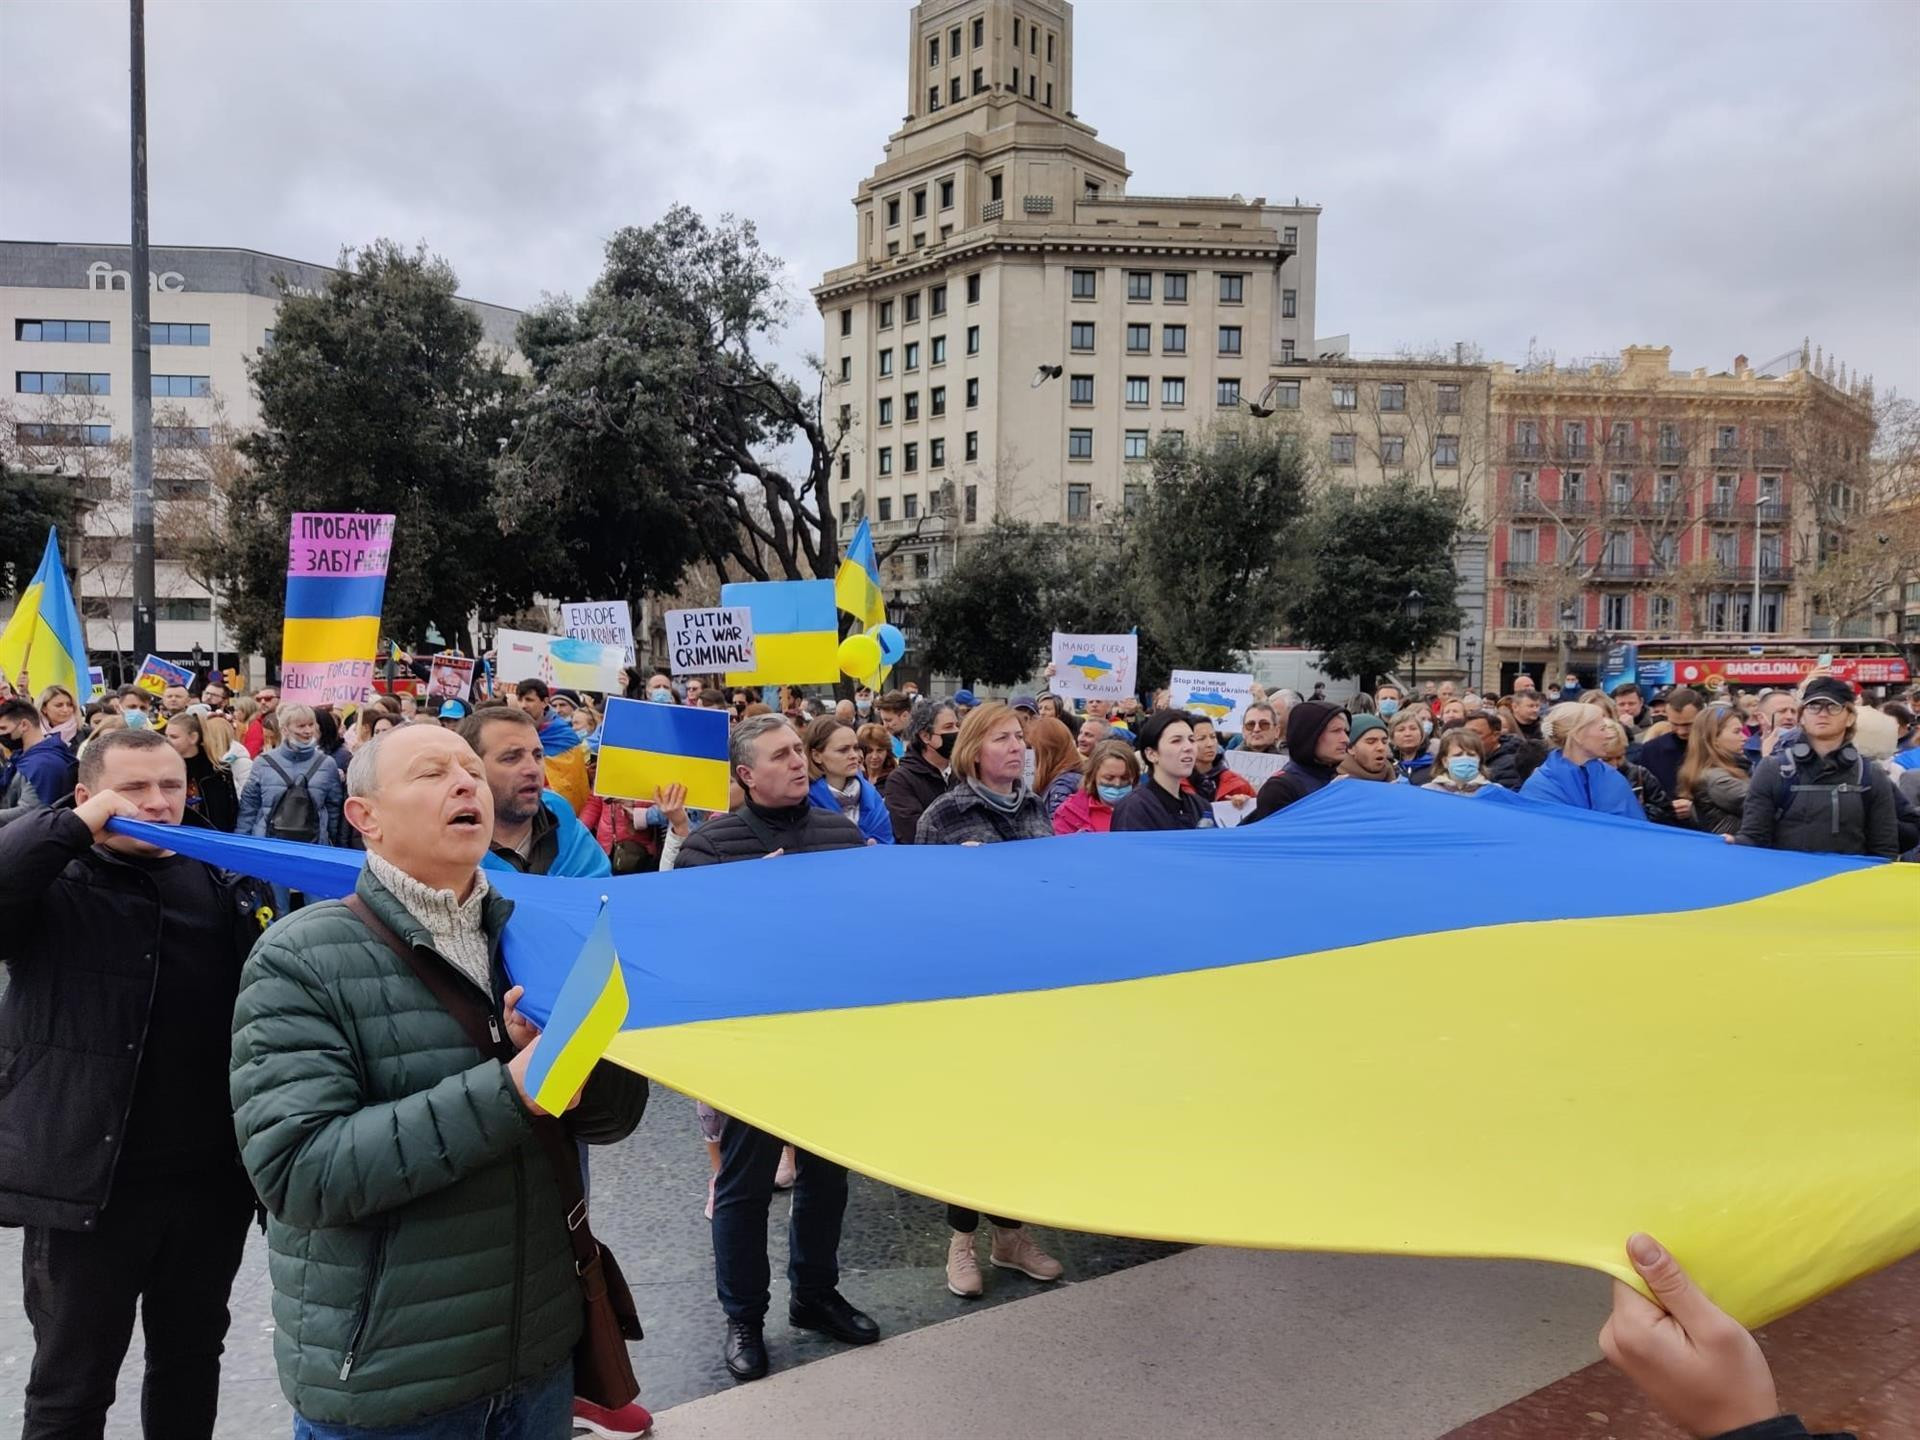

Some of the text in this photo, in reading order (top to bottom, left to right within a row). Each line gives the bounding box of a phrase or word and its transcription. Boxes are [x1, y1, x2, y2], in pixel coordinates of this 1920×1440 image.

[571, 607, 616, 626] EUROPE
[683, 612, 732, 629] PUTIN
[677, 626, 742, 646] IS A WAR
[676, 644, 749, 668] CRIMINAL
[1101, 643, 1126, 654] FUERA
[327, 661, 371, 679] FORGET
[1727, 662, 1799, 675] BARCELONA
[306, 675, 325, 690] NOT
[1173, 677, 1192, 685] Stop
[1191, 685, 1219, 693] against
[321, 685, 370, 703] FORGIVE
